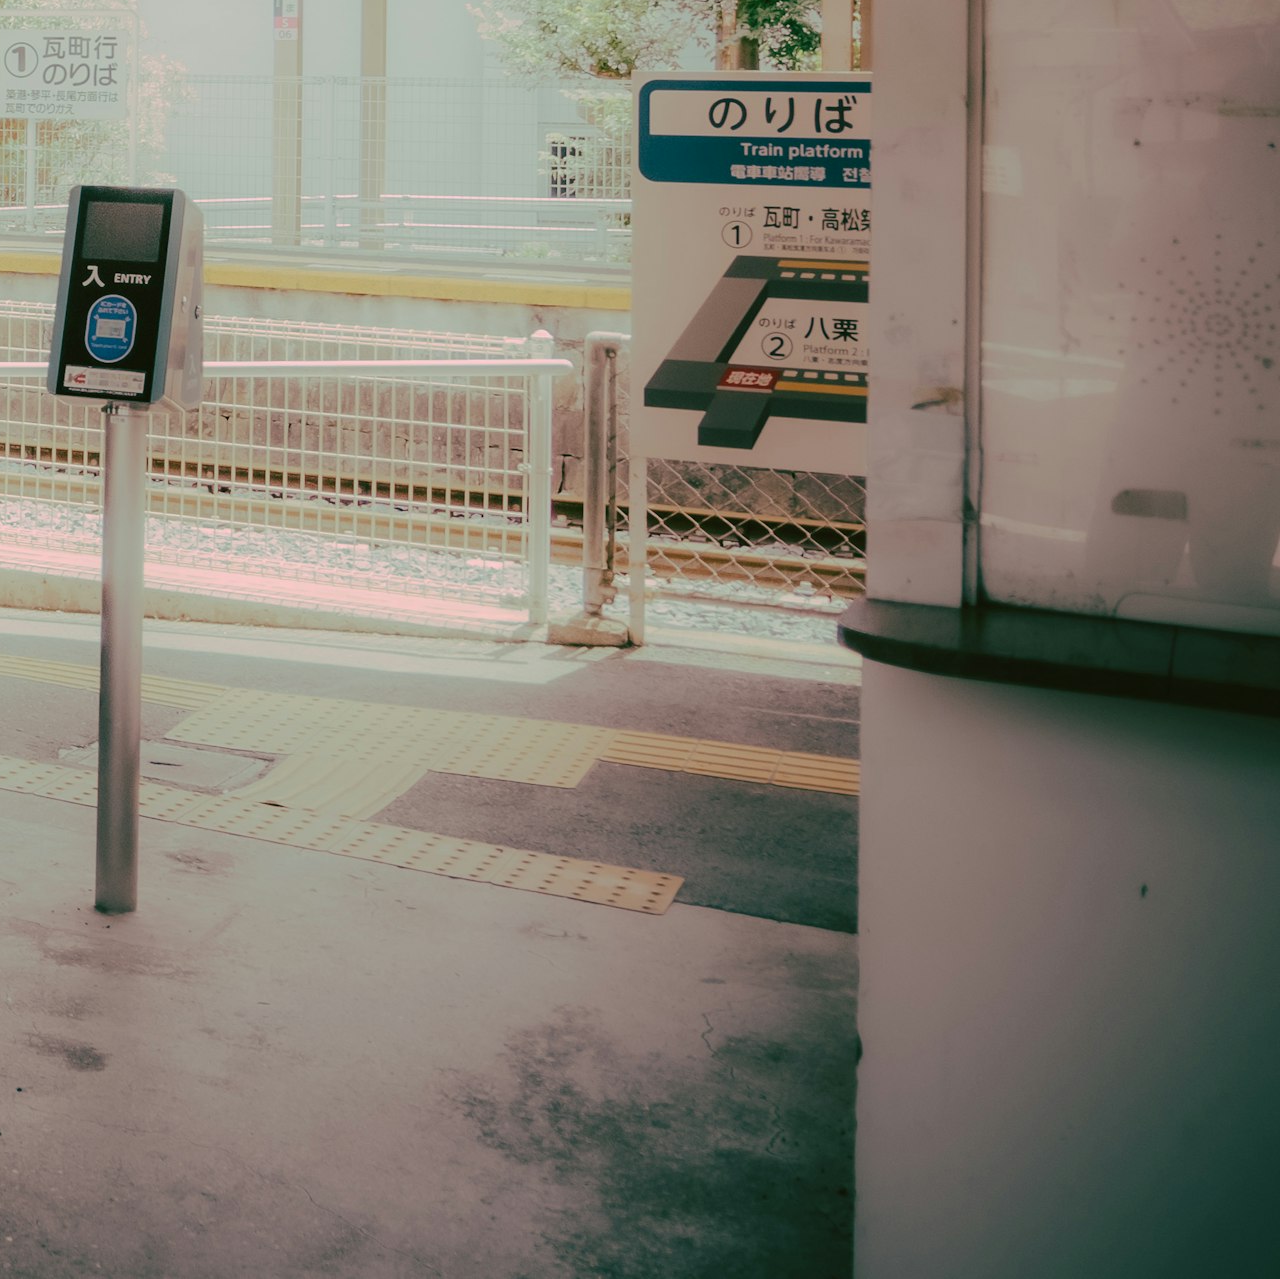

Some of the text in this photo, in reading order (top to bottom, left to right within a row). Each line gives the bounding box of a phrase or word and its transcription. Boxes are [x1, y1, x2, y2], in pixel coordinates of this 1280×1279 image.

[282, 19, 289, 28] S
[278, 30, 293, 39] 06
[42, 35, 118, 60] 瓦町行
[42, 62, 118, 86] のりば
[5, 103, 75, 115] 瓦町でのりかえ
[709, 95, 857, 133] のりば
[740, 142, 784, 156] Train
[789, 144, 863, 160] platform
[719, 207, 756, 217] のりば
[763, 233, 797, 243] Platform
[82, 265, 105, 287] 入
[113, 273, 152, 285] ENTRY
[759, 317, 796, 329] のりば
[804, 317, 859, 342] 八栗
[803, 344, 849, 355] Platform
